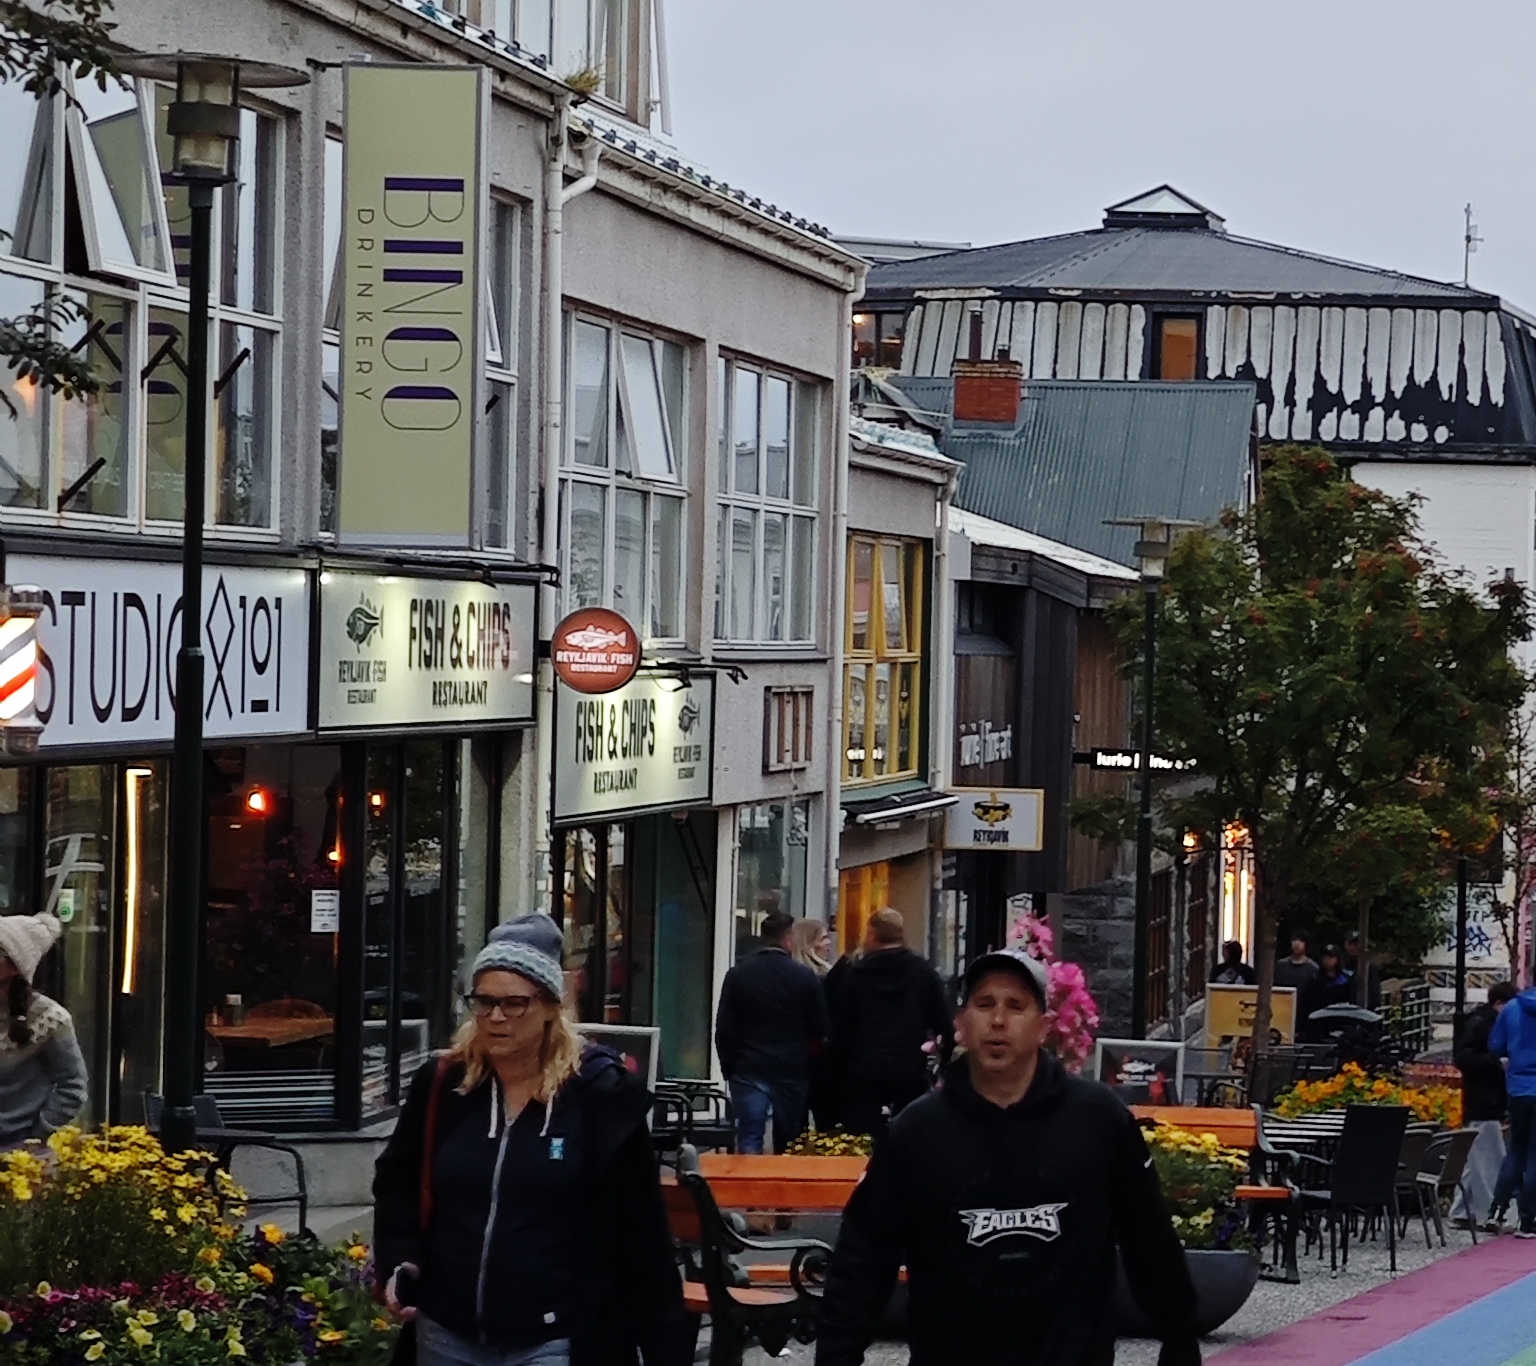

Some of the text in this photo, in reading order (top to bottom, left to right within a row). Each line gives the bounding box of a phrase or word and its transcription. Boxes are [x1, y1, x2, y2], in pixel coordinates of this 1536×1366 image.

[355, 208, 375, 401] DRINKERY
[381, 177, 465, 431] BINGO
[239, 595, 282, 714] 101
[408, 598, 511, 670] FISH & CHIPS
[610, 652, 633, 665] FISH
[432, 680, 488, 707] RESTAURANT
[575, 698, 656, 765] FISH & CHIPS
[593, 767, 638, 794] RESTAURANT
[966, 1206, 1060, 1240] EAGLES
